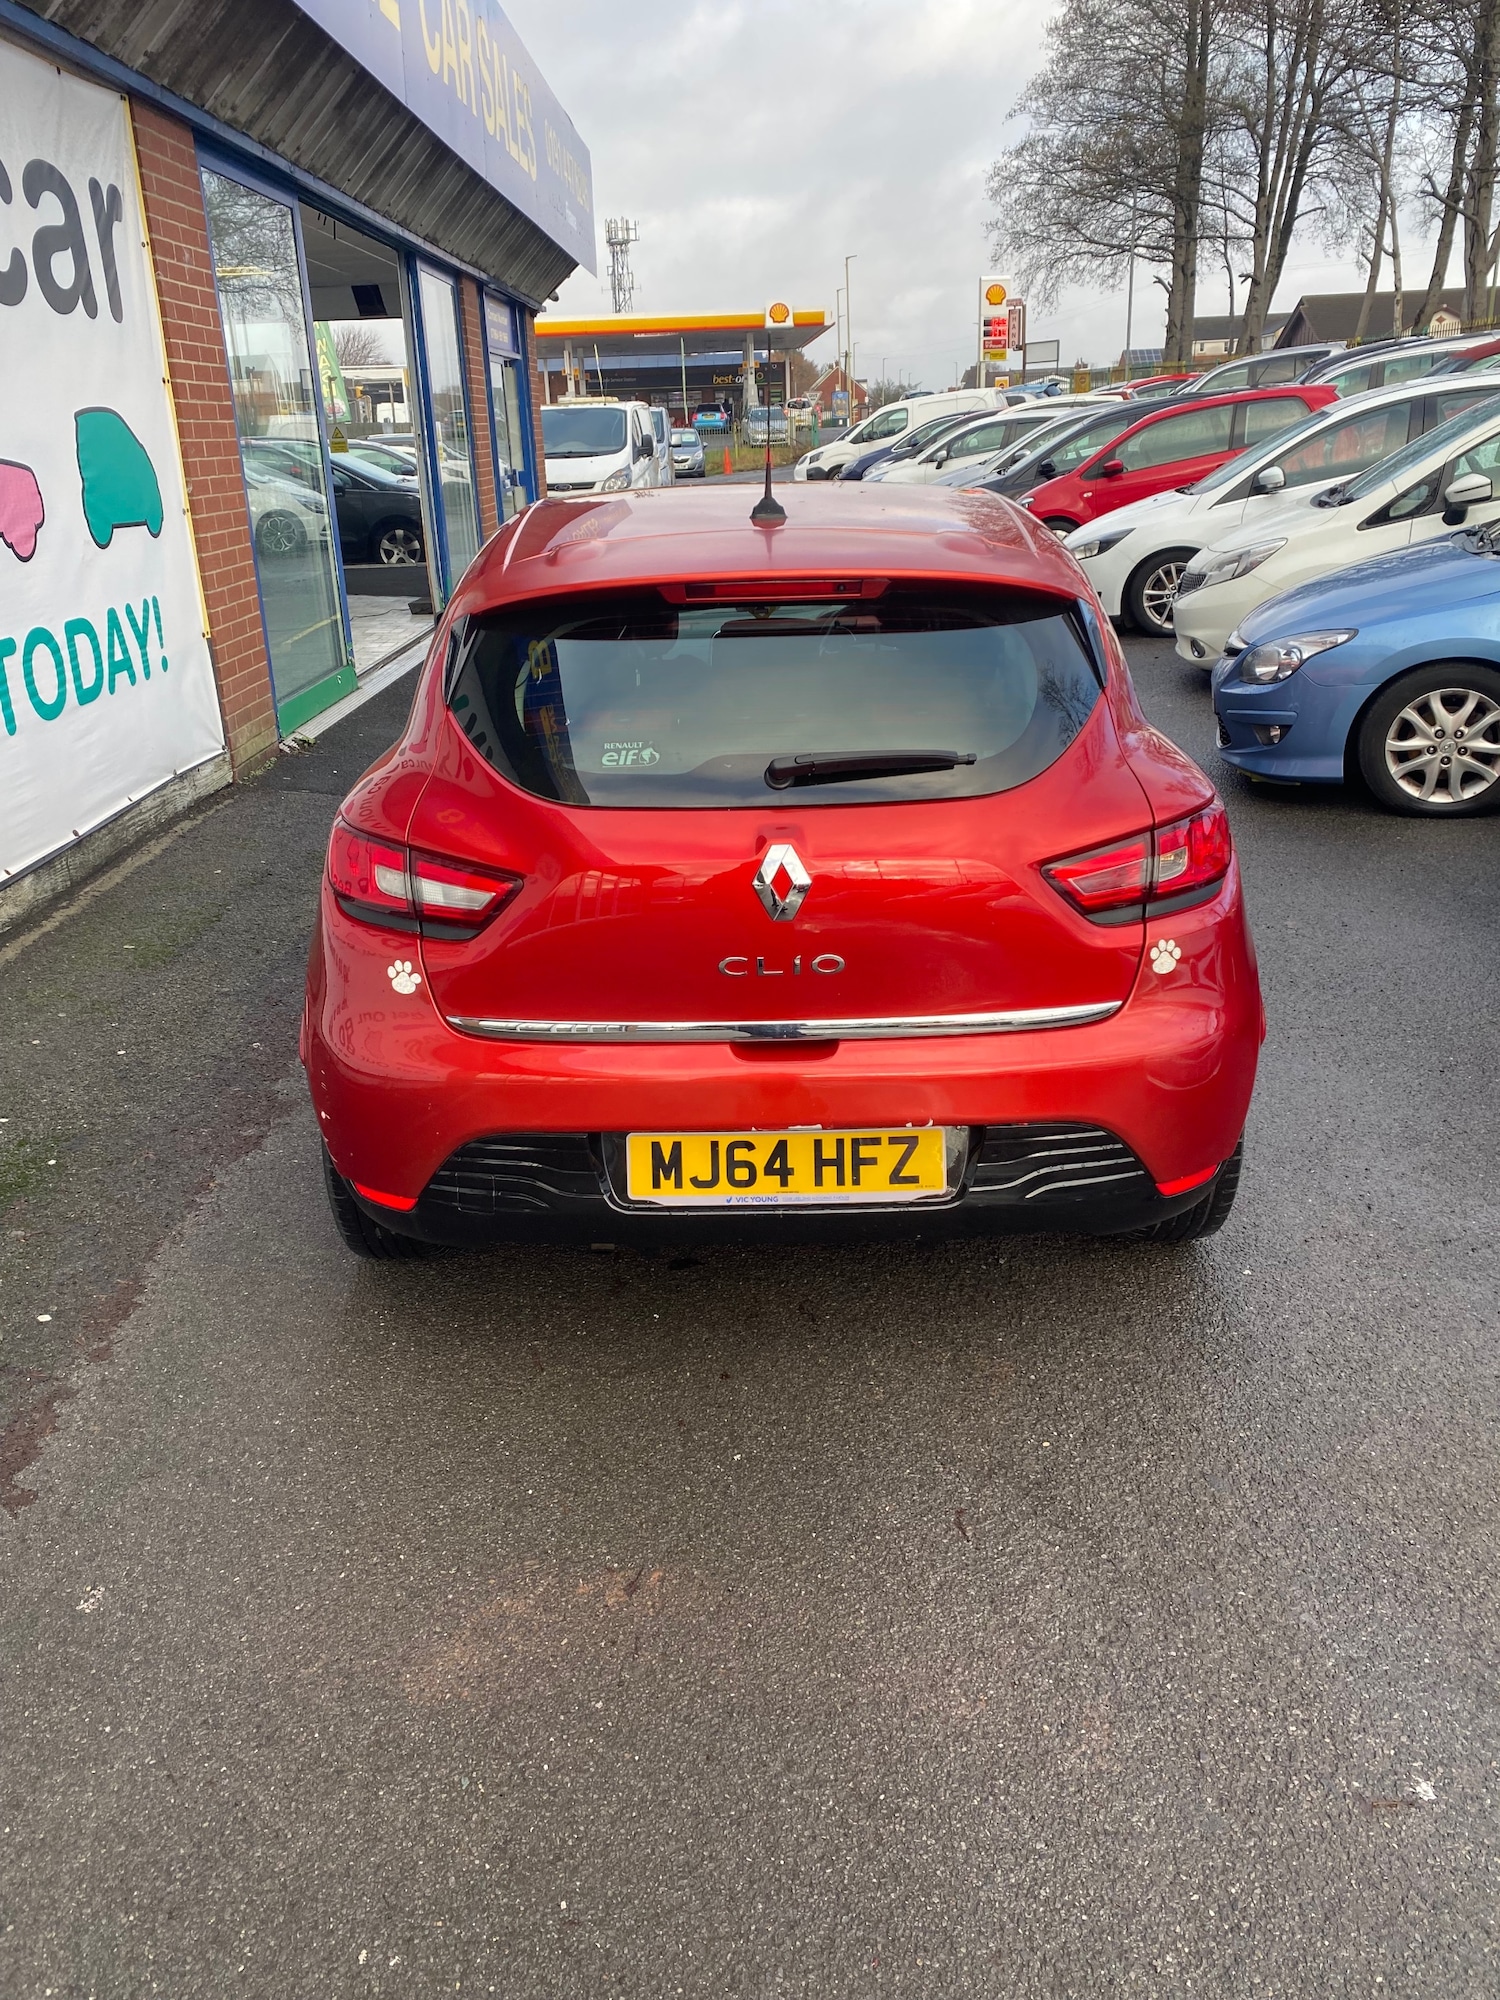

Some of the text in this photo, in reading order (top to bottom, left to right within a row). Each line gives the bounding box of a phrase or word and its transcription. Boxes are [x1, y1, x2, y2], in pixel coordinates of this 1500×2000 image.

[418, 0, 478, 117] CAR
[476, 15, 537, 182] SALES
[712, 374, 744, 385] best-o
[0, 595, 169, 737] TODAY!
[603, 741, 644, 749] RENAULT
[601, 749, 639, 766] elf
[718, 953, 846, 977] CLIO
[652, 1135, 920, 1190] MJ64 HFZ
